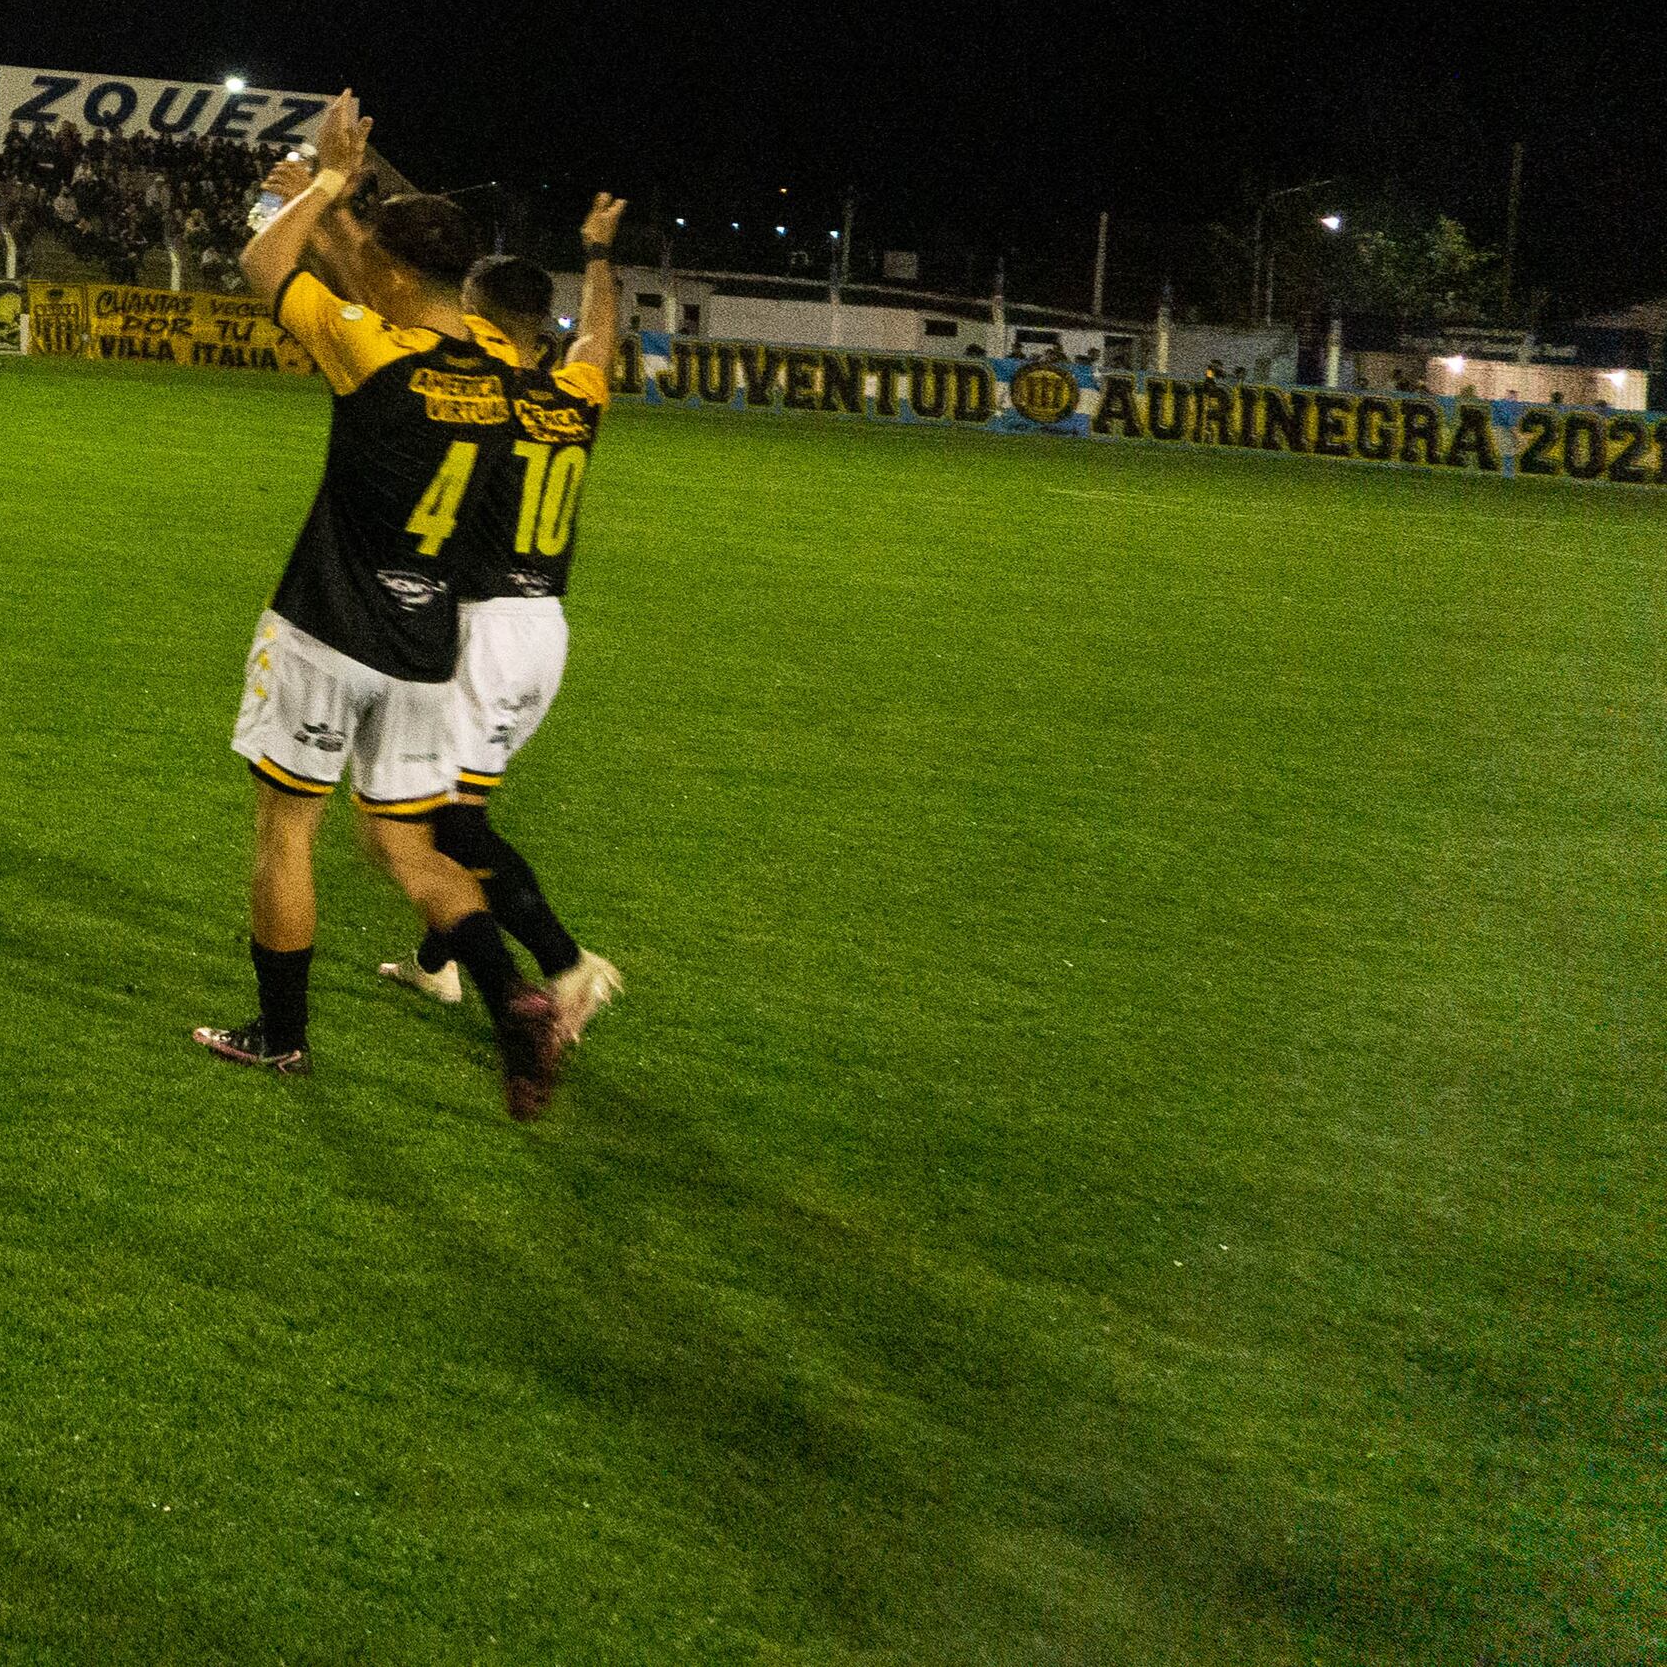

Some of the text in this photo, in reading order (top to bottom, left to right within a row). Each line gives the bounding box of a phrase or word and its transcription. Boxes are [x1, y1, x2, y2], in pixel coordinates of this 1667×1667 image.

[99, 335, 280, 371] VILLA ITALIA
[121, 316, 194, 337] POR
[216, 320, 257, 342] TU
[658, 340, 994, 424] JUVENTUD
[1092, 376, 1502, 473] AURINEGRA
[405, 440, 587, 556] 4 10
